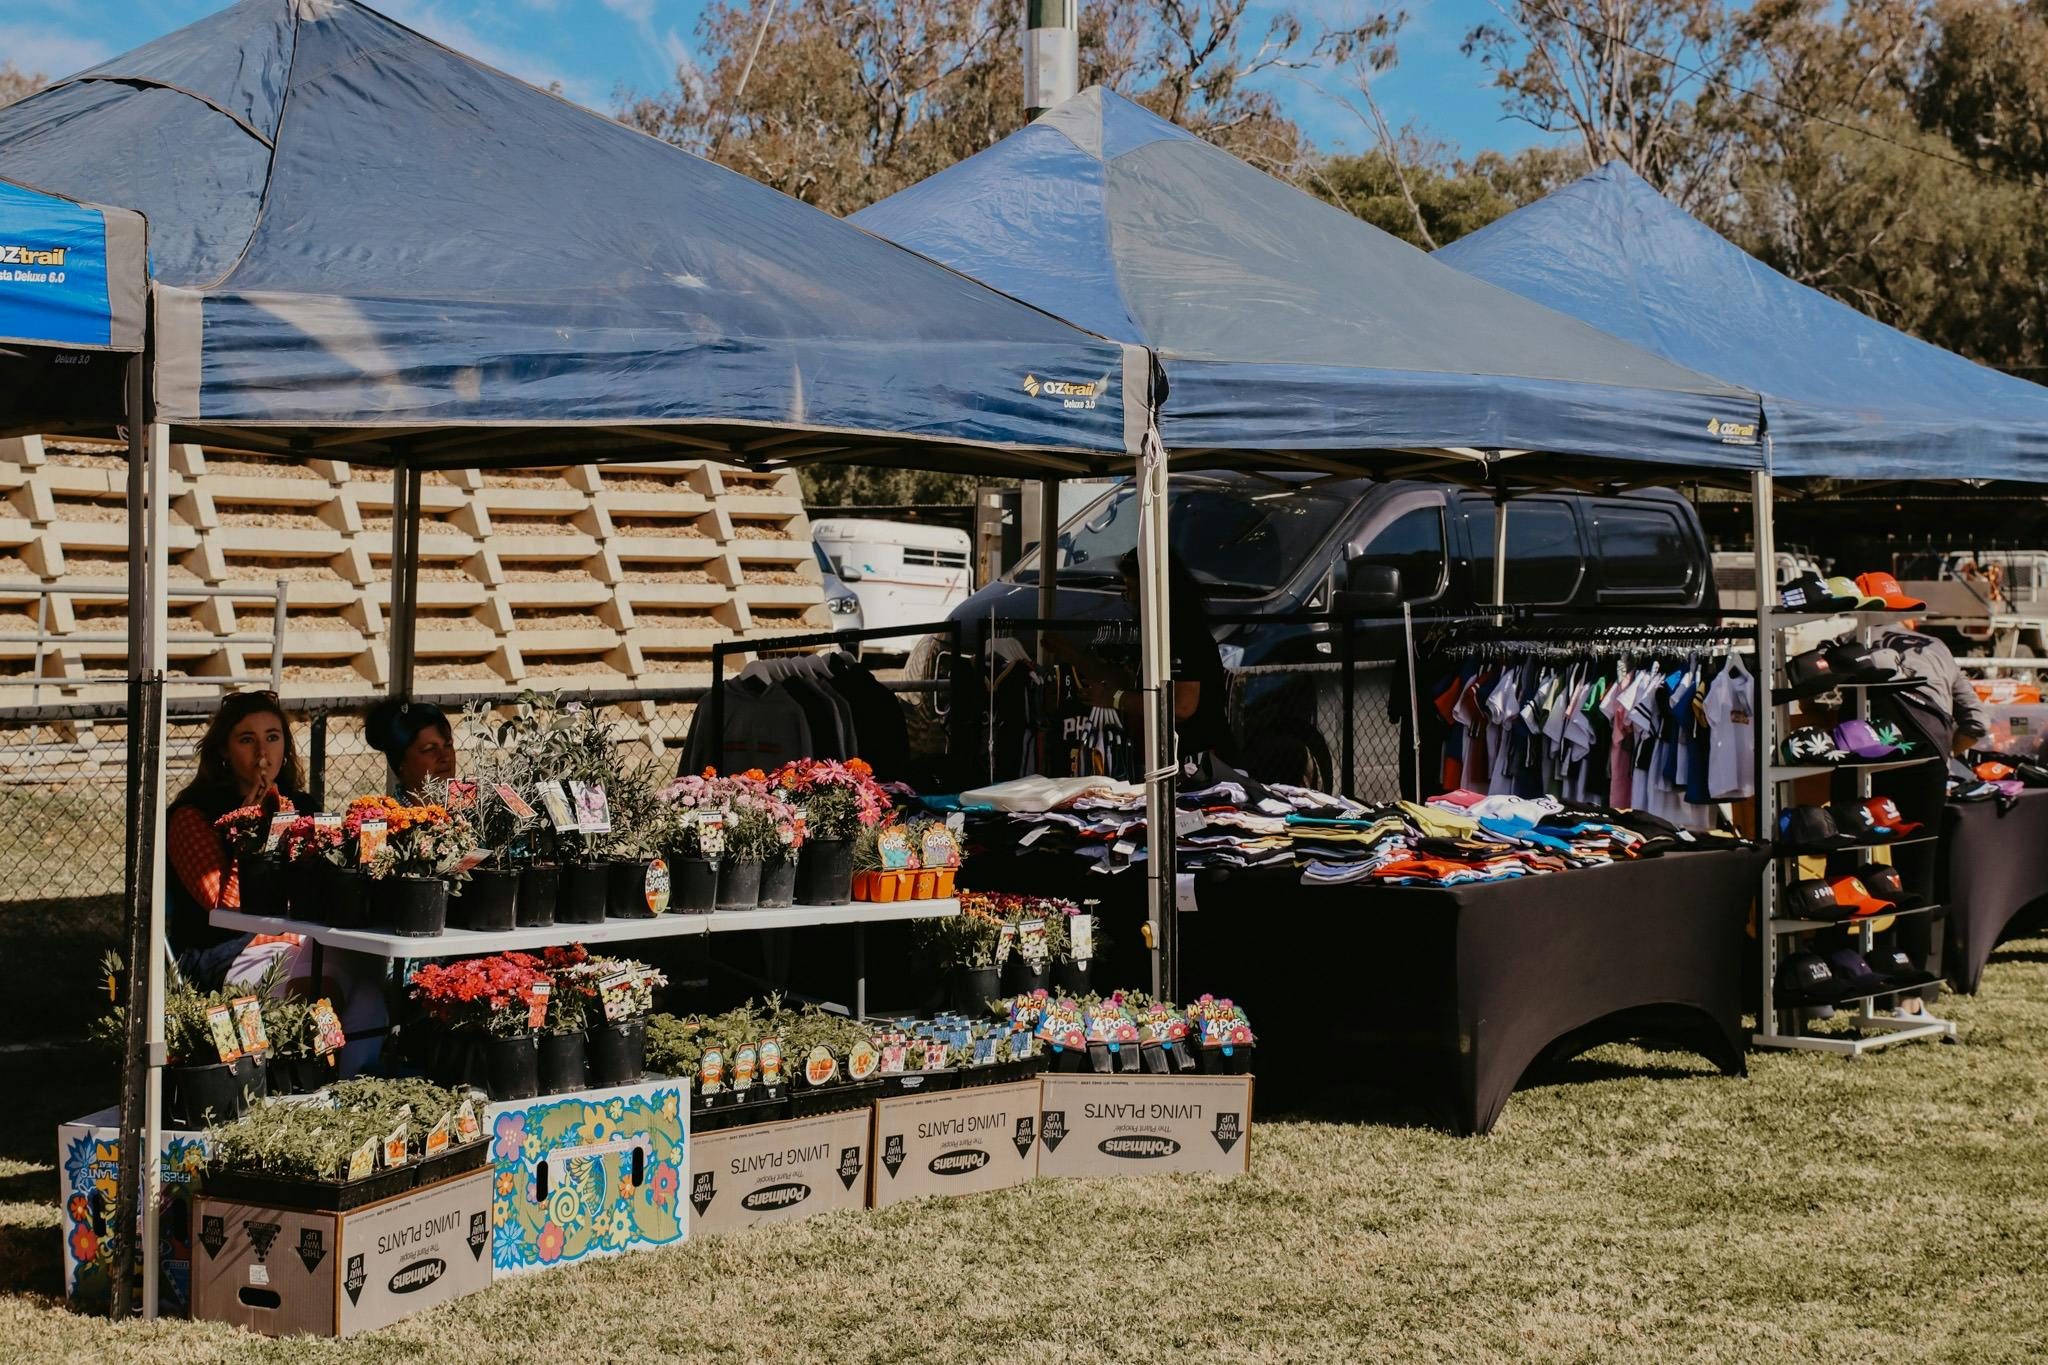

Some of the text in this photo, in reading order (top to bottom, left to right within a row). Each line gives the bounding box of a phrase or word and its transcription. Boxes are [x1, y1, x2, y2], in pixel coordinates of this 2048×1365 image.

[0, 246, 66, 266] Ztrail
[14, 270, 46, 283] Deluxe
[48, 271, 65, 283] 6.0
[1043, 381, 1097, 396] OZtrail
[1064, 399, 1096, 409] Deluxe 3.0
[1017, 994, 1046, 1009] MEGA
[1046, 1003, 1074, 1021] MEGA
[1089, 1006, 1120, 1019] MEGA
[1137, 1011, 1169, 1024] MEGA
[1204, 1005, 1234, 1020] MEGA
[1047, 1113, 1059, 1121] UP
[1084, 1103, 1201, 1119] LIVING PLANTS
[1020, 1119, 1030, 1128] UP
[1222, 1115, 1234, 1123] UP
[918, 1112, 1006, 1139] LIVING PLANTS
[1018, 1127, 1031, 1136] WAY
[1043, 1121, 1062, 1130] WAY
[1216, 1123, 1236, 1131] WAY
[1043, 1129, 1063, 1138] THIS
[1218, 1131, 1237, 1140] THIS
[889, 1137, 900, 1146] UP
[1017, 1135, 1031, 1145] THIS
[845, 1149, 856, 1159] UP
[887, 1146, 901, 1155] WAY
[1105, 1141, 1174, 1155] Pohlmans
[730, 1143, 829, 1175] LIVING PLANTS
[842, 1157, 858, 1168] WAY
[886, 1154, 902, 1165] THIS
[934, 1152, 985, 1171] Pohlmans
[80, 1168, 119, 1180] PLANTS
[841, 1166, 858, 1177] THIS
[698, 1174, 709, 1184] UP
[694, 1182, 711, 1194] WAY
[694, 1191, 711, 1203] THIS
[747, 1185, 806, 1207] Pohlmans
[473, 1214, 483, 1226] UP
[306, 1231, 317, 1240] UP
[377, 1210, 461, 1255] LIVING PLANTS
[472, 1223, 485, 1237] WAY
[304, 1240, 319, 1249] WAY
[471, 1233, 485, 1247] THIS
[303, 1249, 320, 1259] THIS
[351, 1256, 360, 1269] UP
[349, 1266, 362, 1281] WAY
[392, 1260, 443, 1291] Pohlmans
[348, 1277, 363, 1291] THIS
